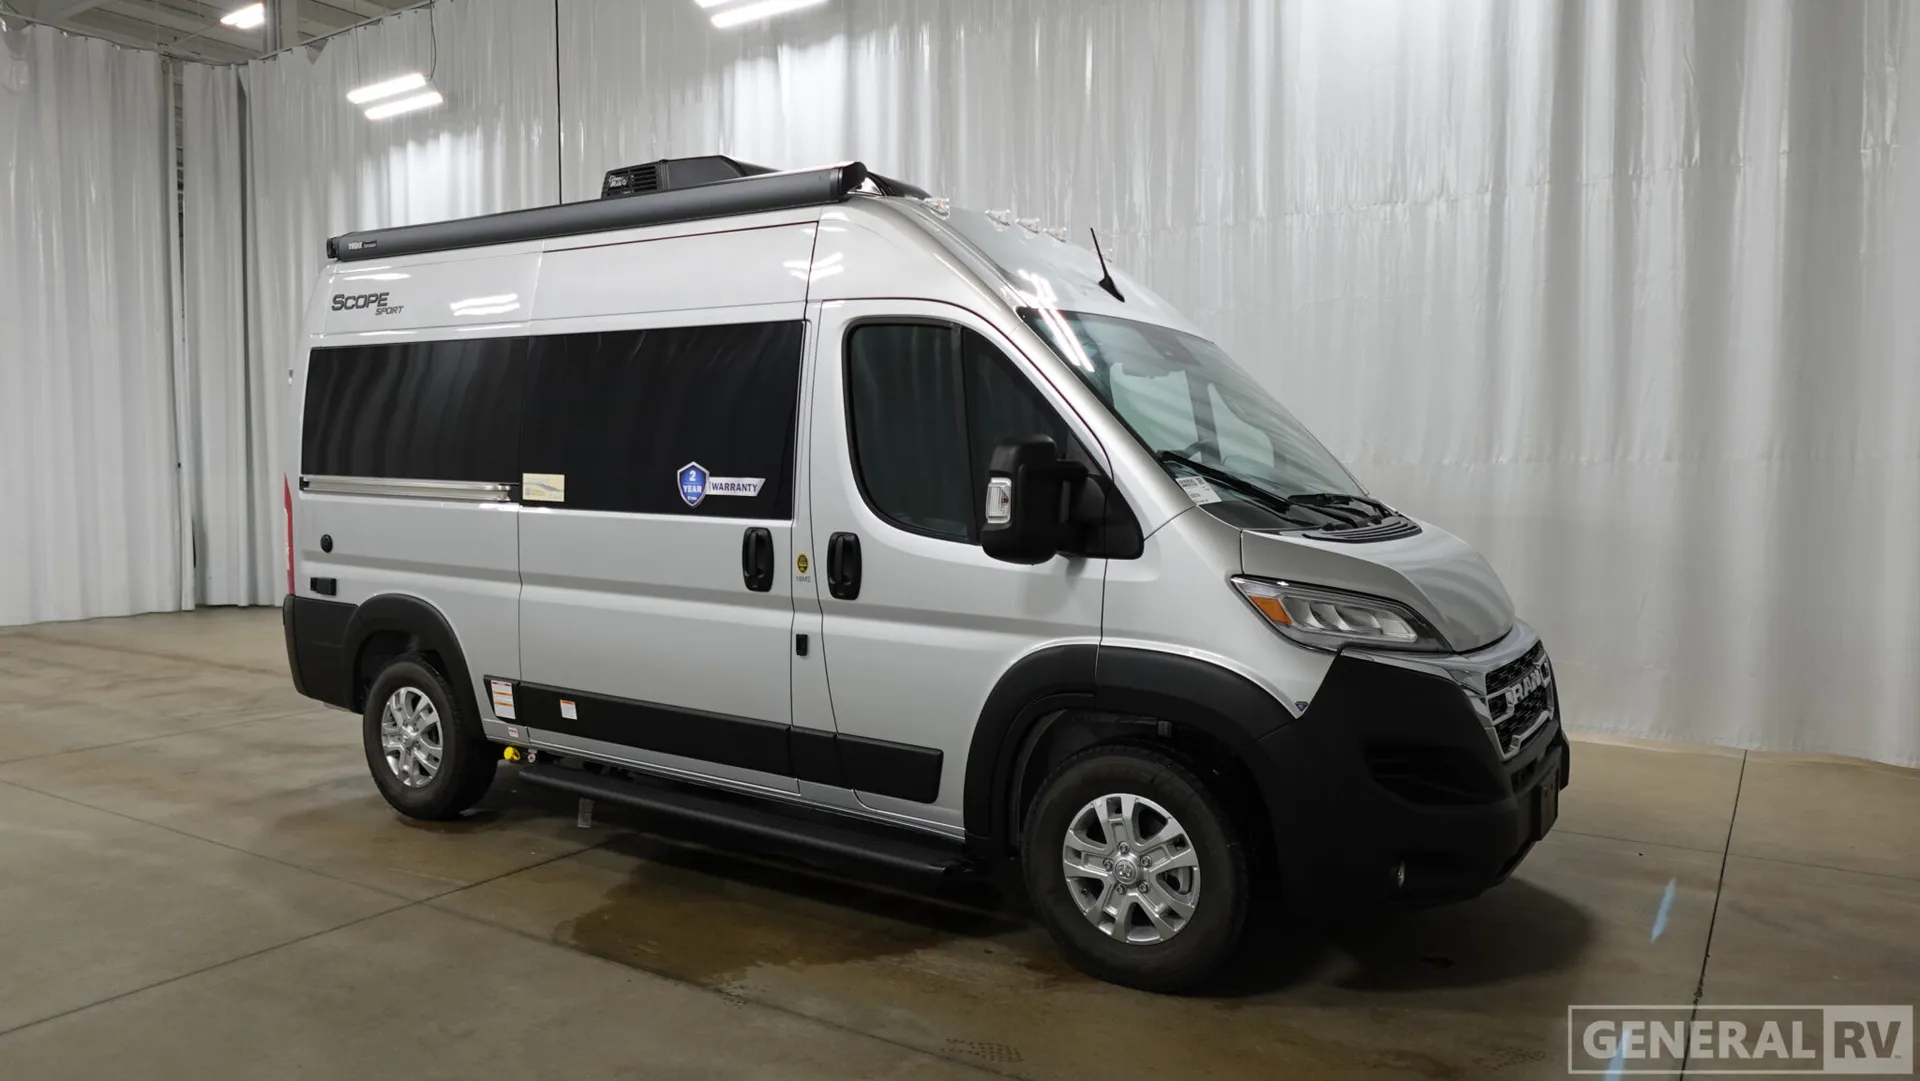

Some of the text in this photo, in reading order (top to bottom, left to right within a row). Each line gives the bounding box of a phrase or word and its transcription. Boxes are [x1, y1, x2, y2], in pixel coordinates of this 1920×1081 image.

[332, 292, 390, 311] SCOPE
[375, 306, 404, 315] SPORT
[689, 470, 696, 481] 2
[683, 485, 702, 493] YEAR
[711, 482, 757, 492] WARRANTY
[1511, 669, 1542, 704] RAM
